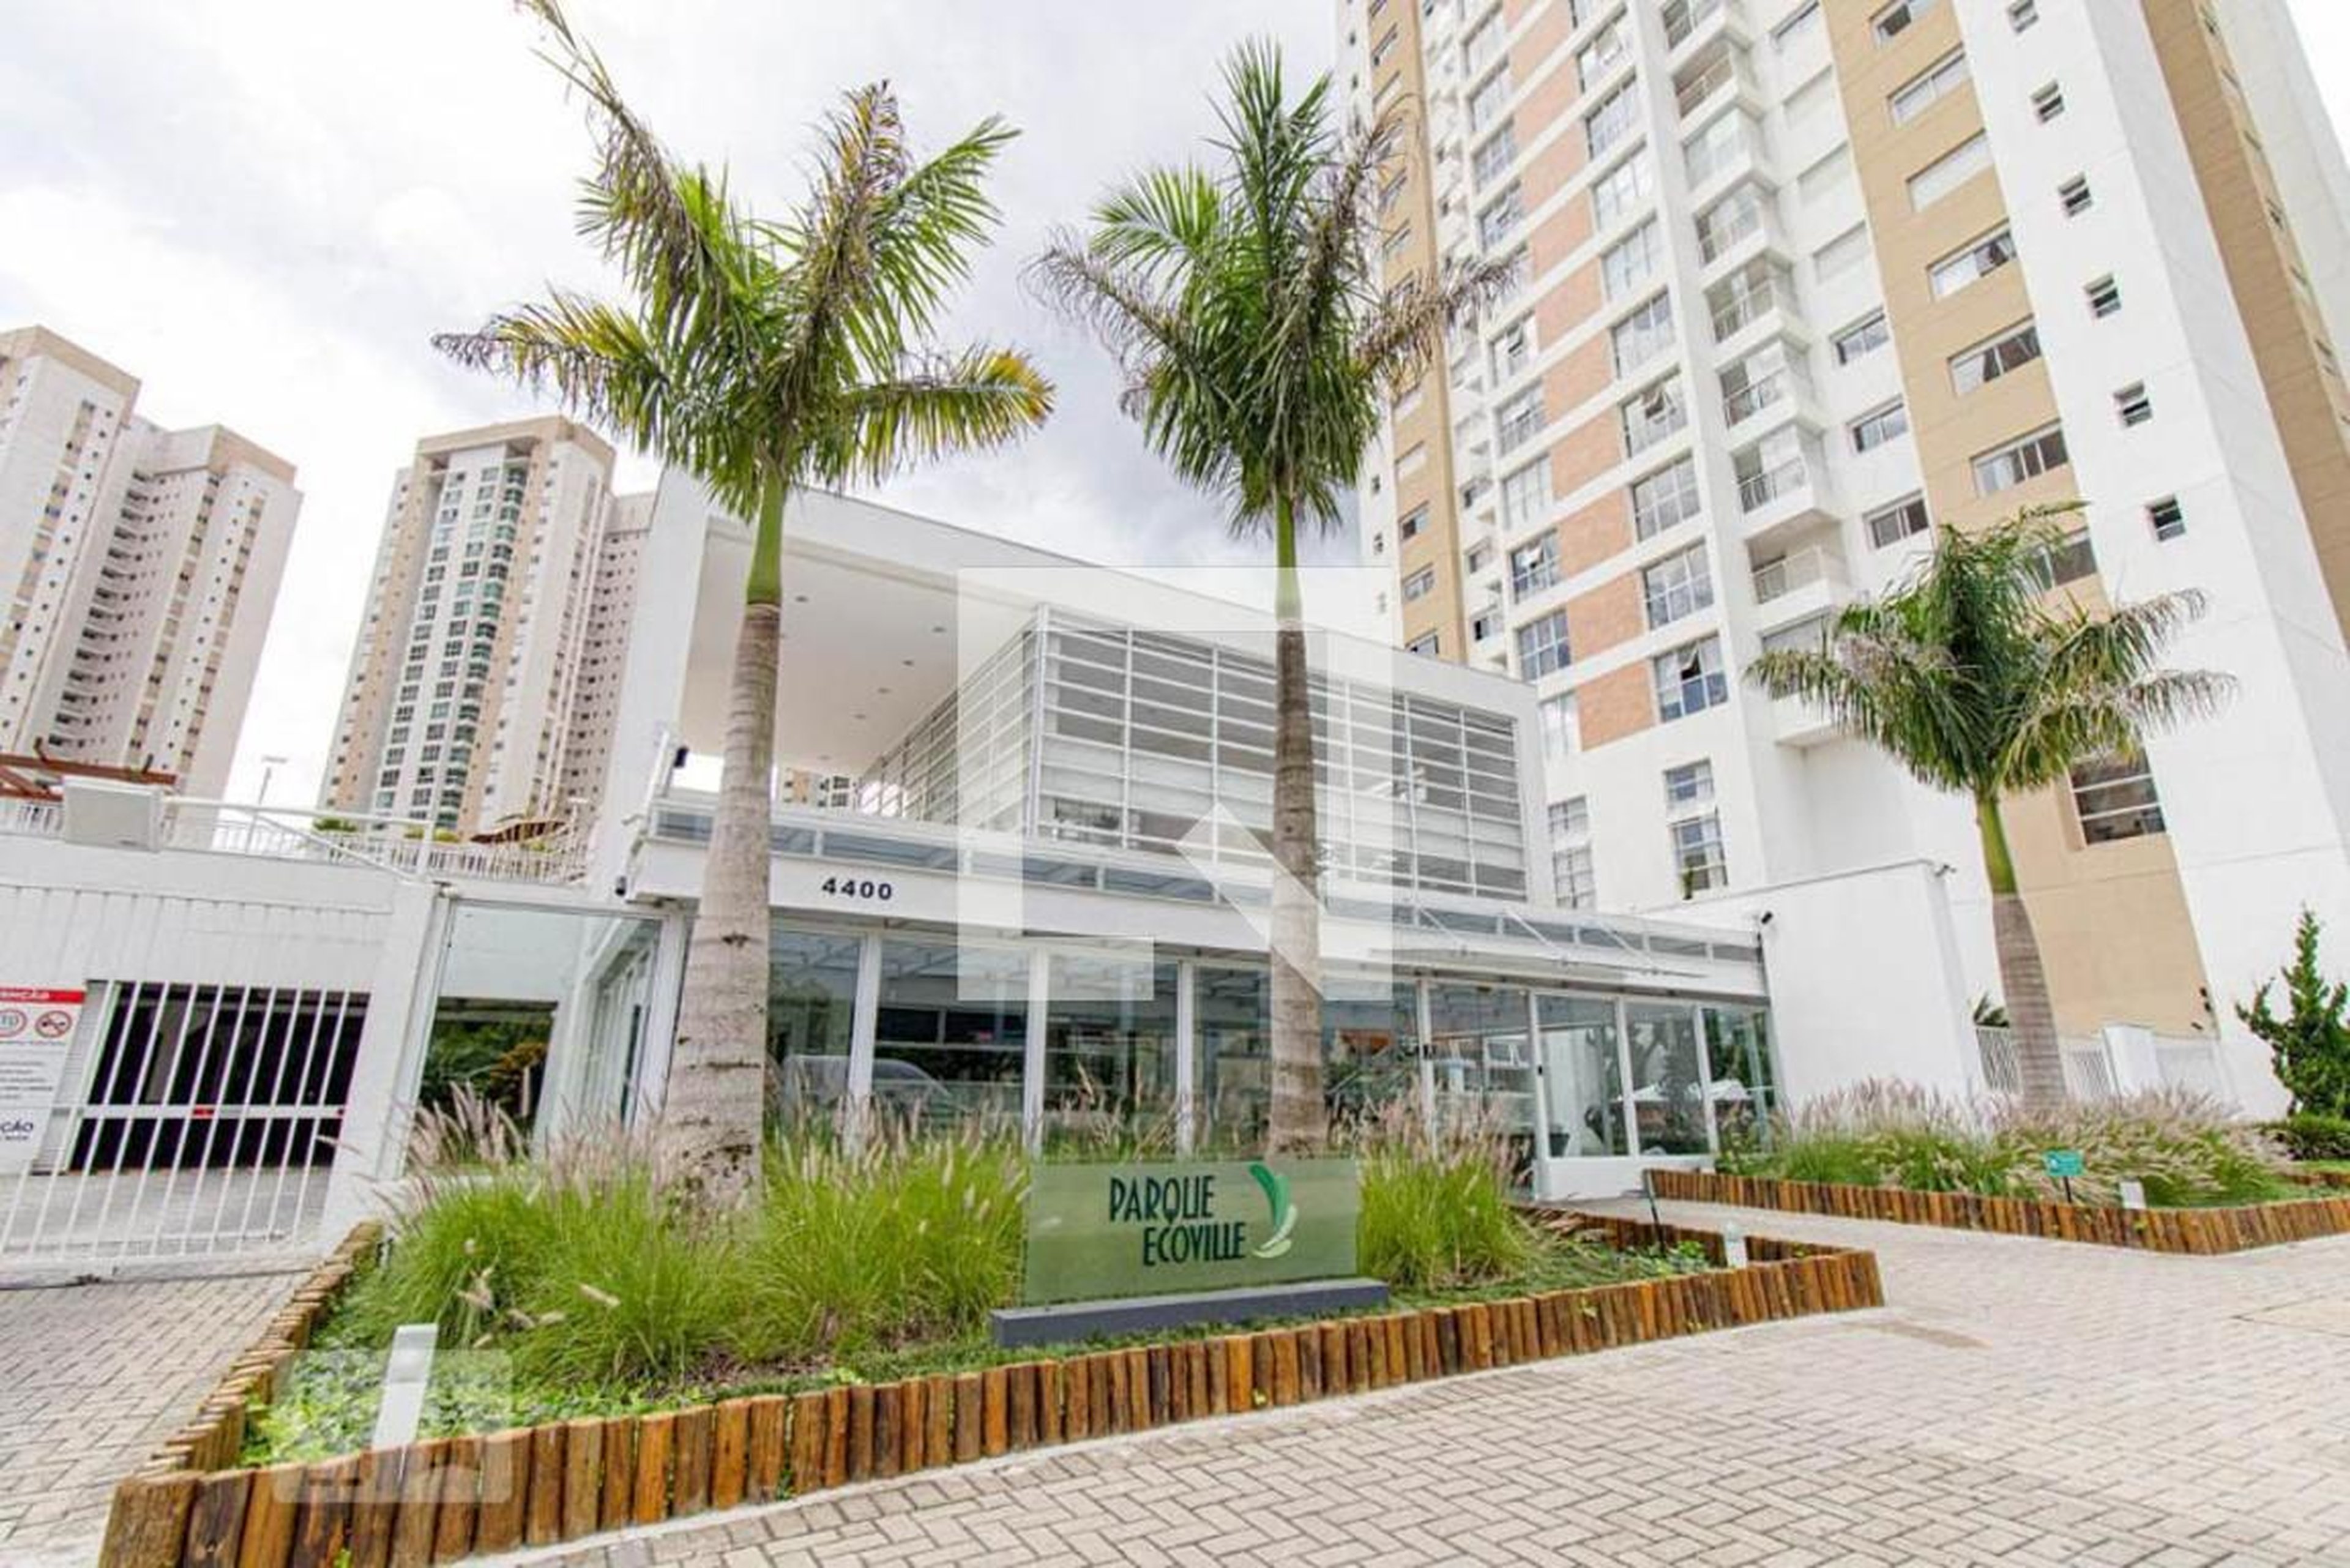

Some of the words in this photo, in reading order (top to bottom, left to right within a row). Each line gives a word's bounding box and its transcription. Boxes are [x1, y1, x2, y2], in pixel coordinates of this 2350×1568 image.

[821, 878, 892, 900] 4400
[1109, 1175, 1215, 1224] PARQUE
[1143, 1222, 1246, 1266] ECOVILLE
